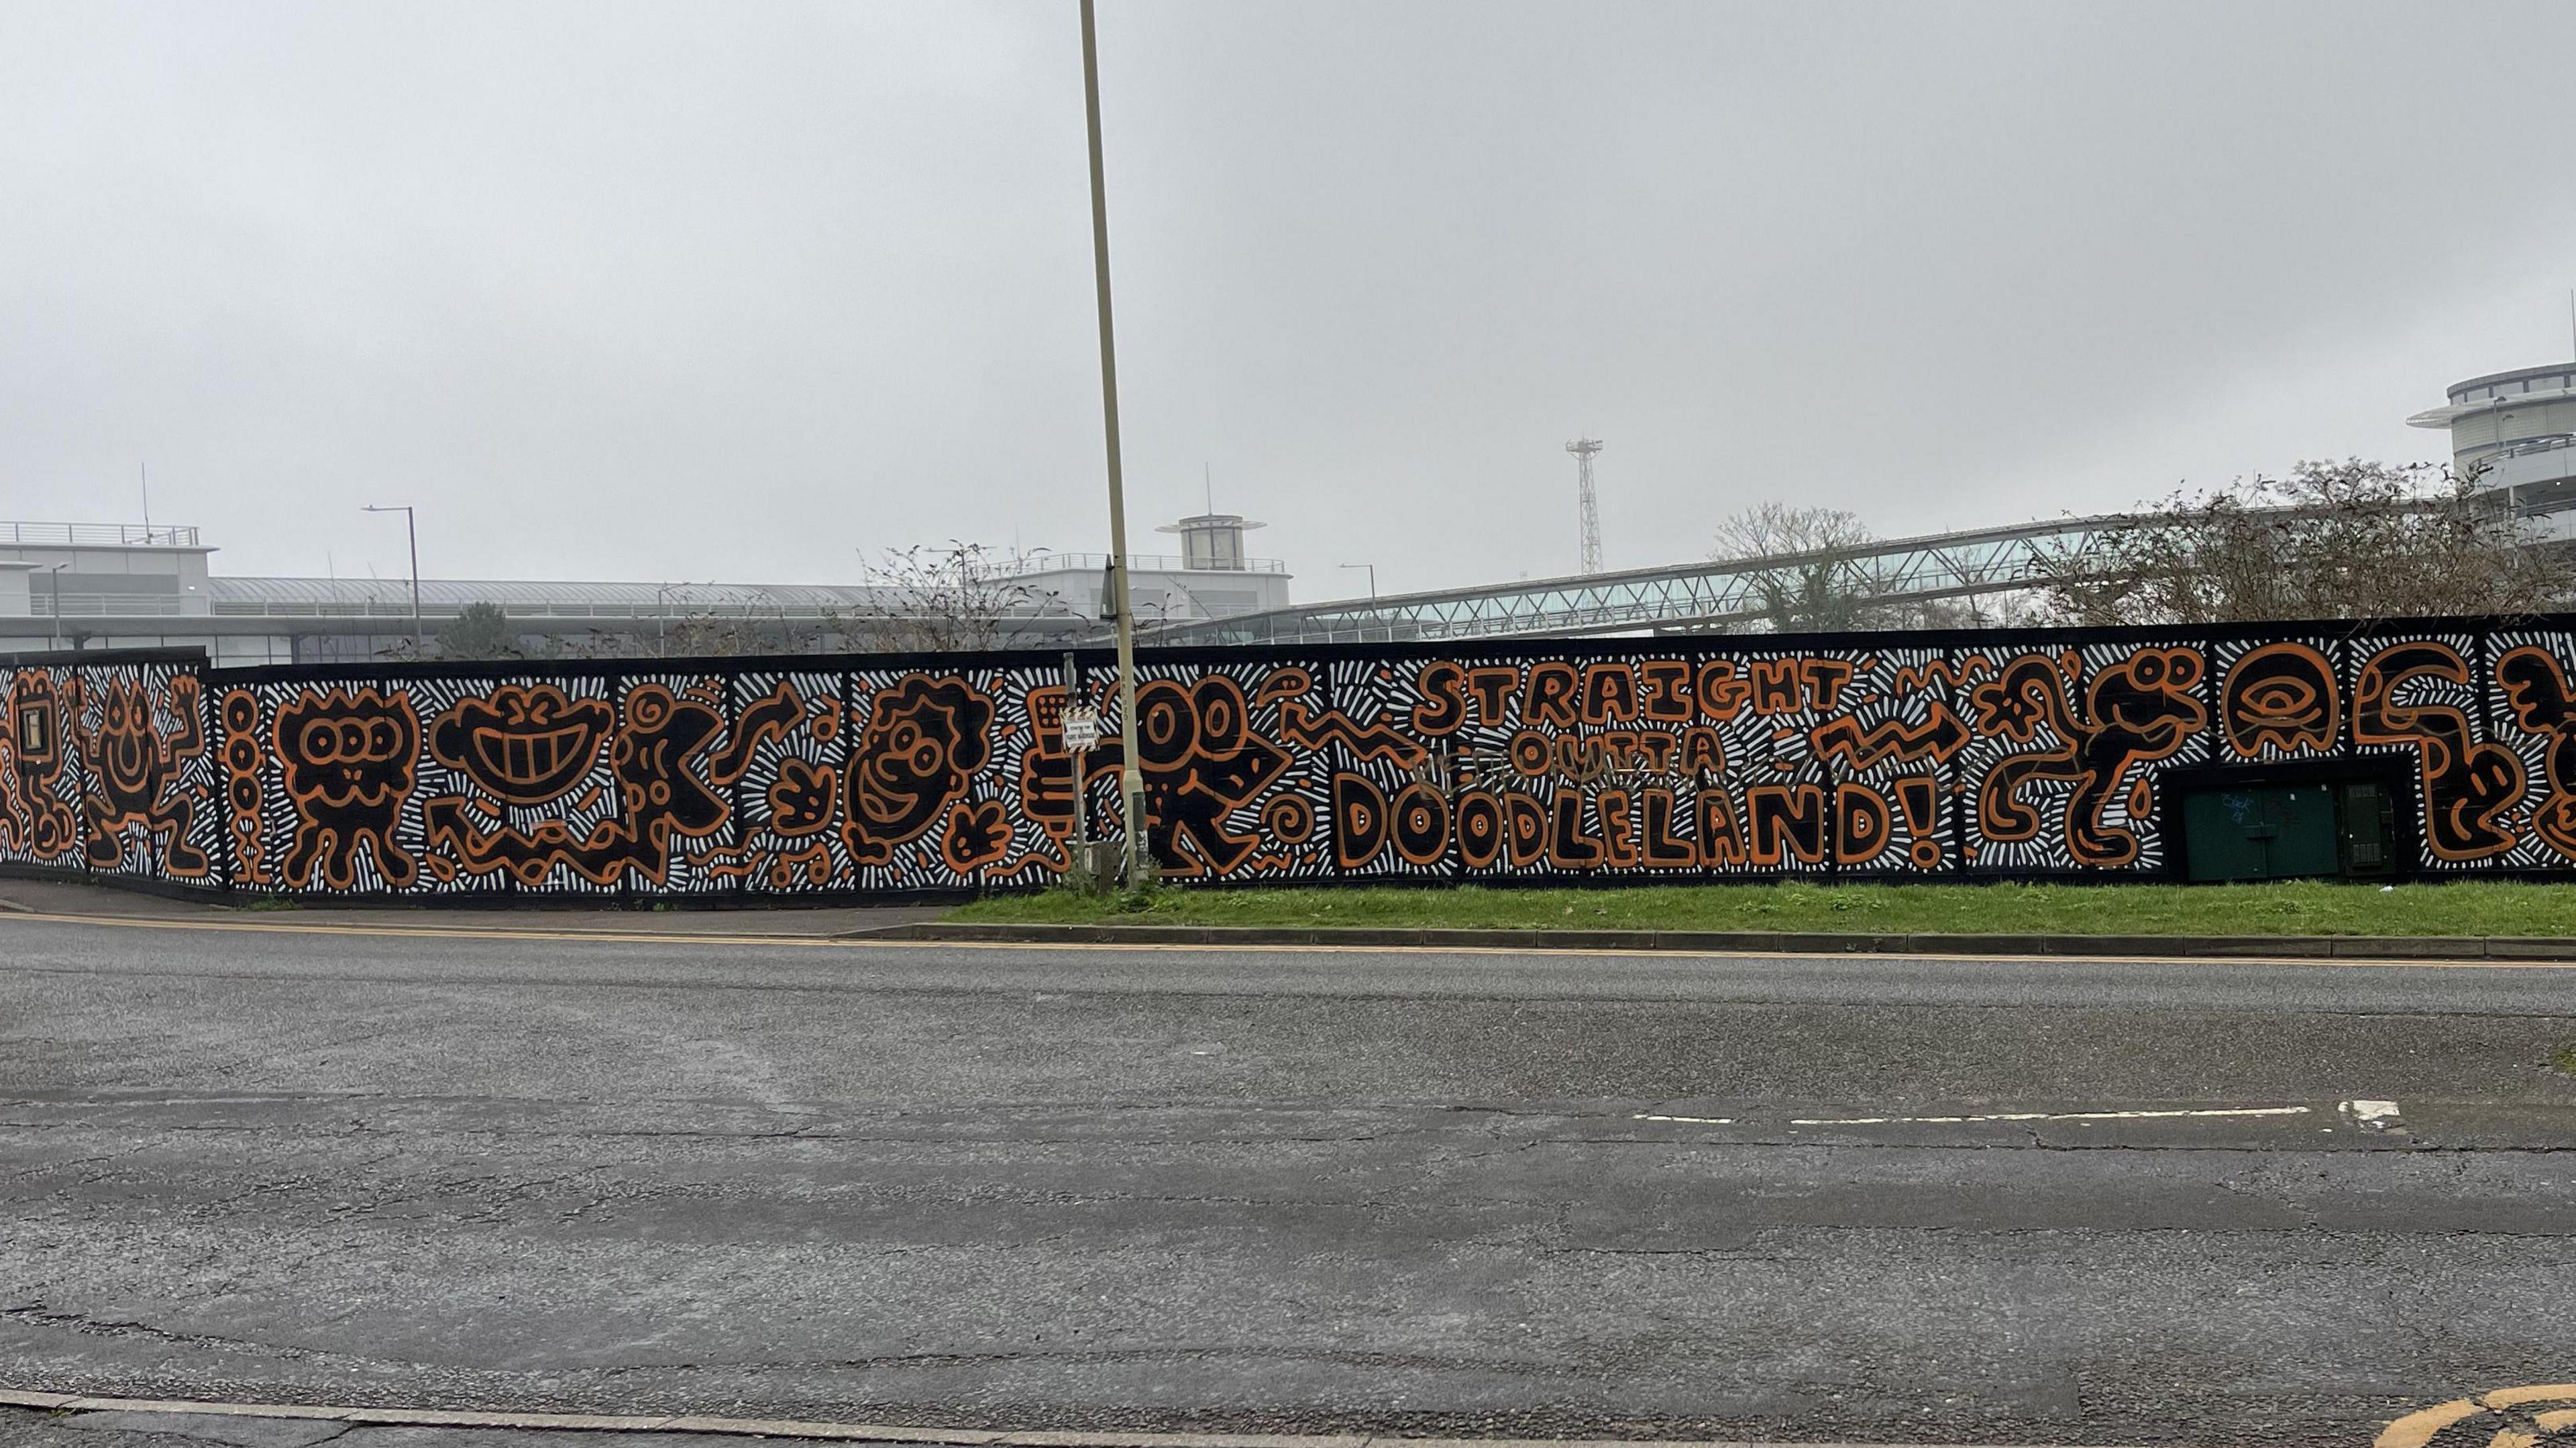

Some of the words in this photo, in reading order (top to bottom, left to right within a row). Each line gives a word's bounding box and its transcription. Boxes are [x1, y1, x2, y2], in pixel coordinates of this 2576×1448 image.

[1413, 658, 1853, 736] STRAIGHT
[1510, 727, 1725, 781] OUTTA
[1334, 772, 1939, 869] DOODLELAND!
